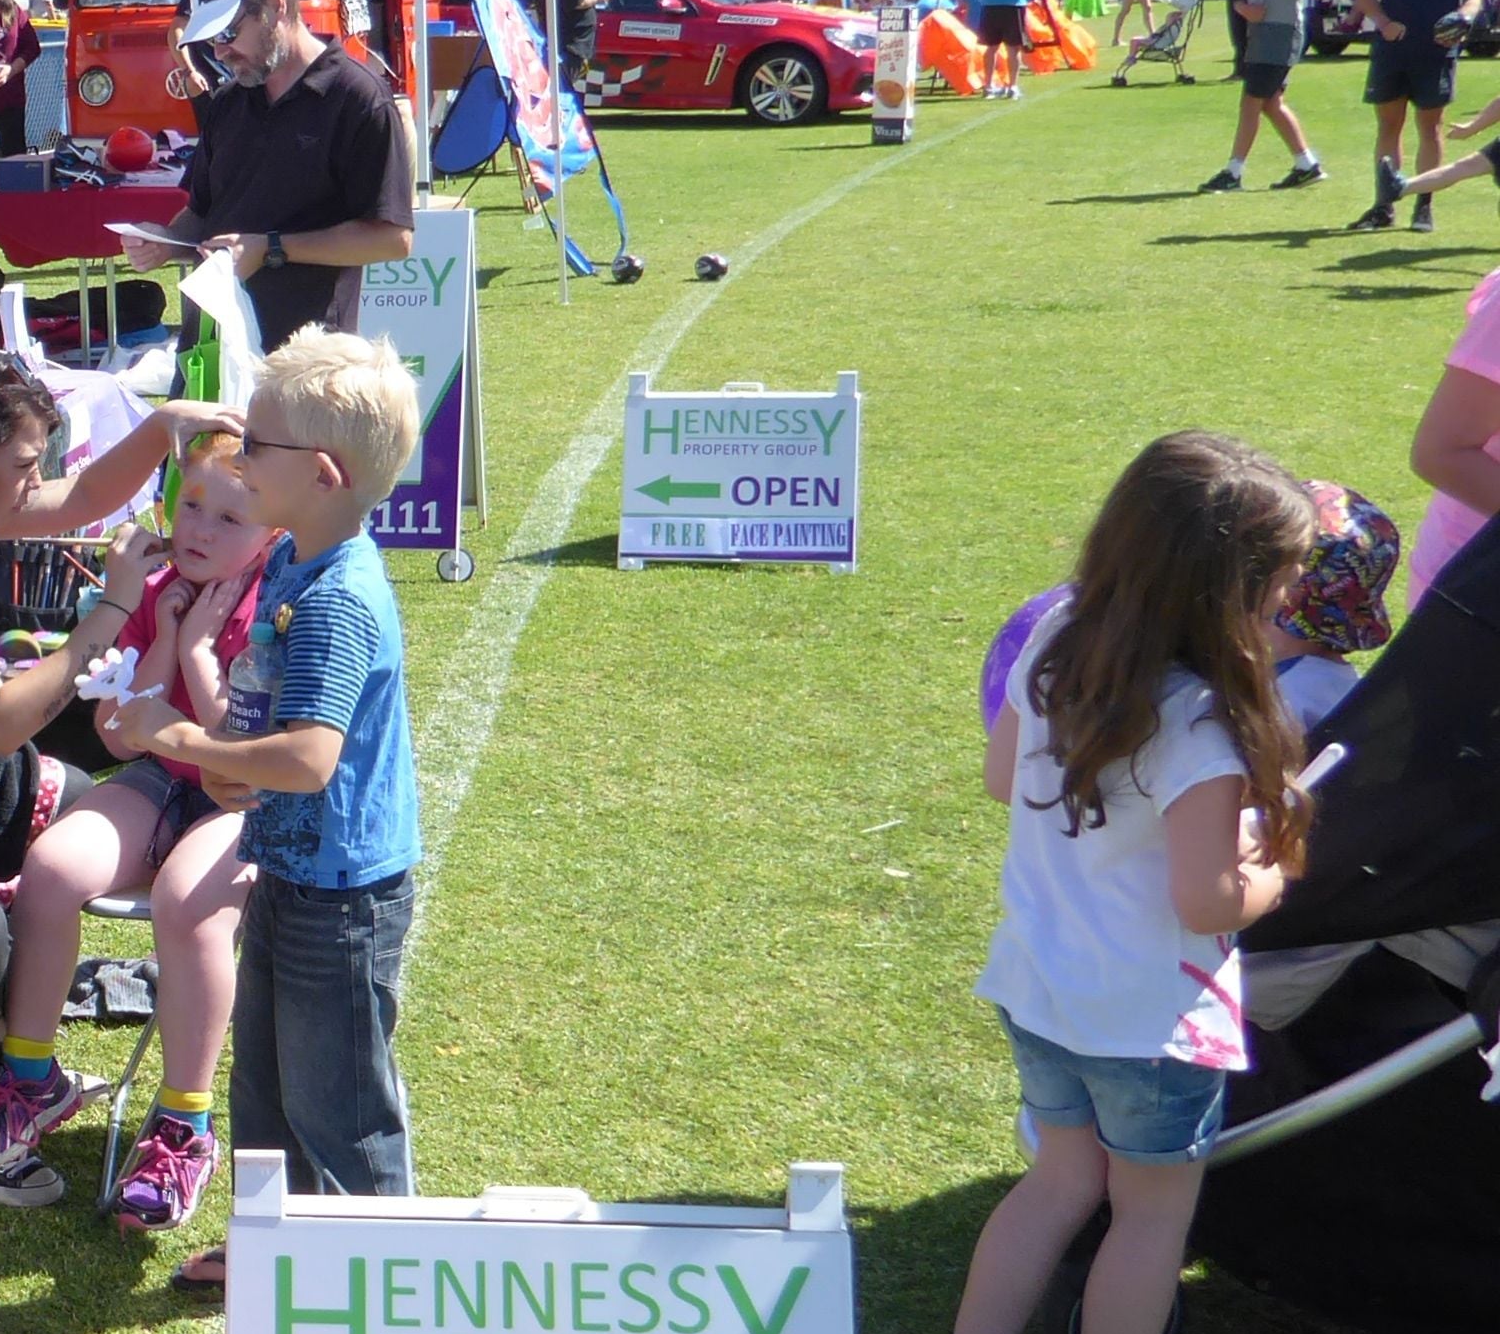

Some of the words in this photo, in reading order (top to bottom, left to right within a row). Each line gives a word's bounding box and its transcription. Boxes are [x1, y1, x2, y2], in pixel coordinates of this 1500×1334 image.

[880, 8, 904, 20] NOW
[879, 20, 904, 31] OPEN
[374, 294, 428, 307] GROUP
[643, 409, 847, 457] HENNESSY
[683, 442, 759, 457] PROPERTY
[763, 443, 818, 457] GROUP
[731, 475, 840, 507] OPEN
[650, 522, 706, 547] FREE
[730, 522, 769, 548] FACE
[772, 522, 847, 549] PAINTING
